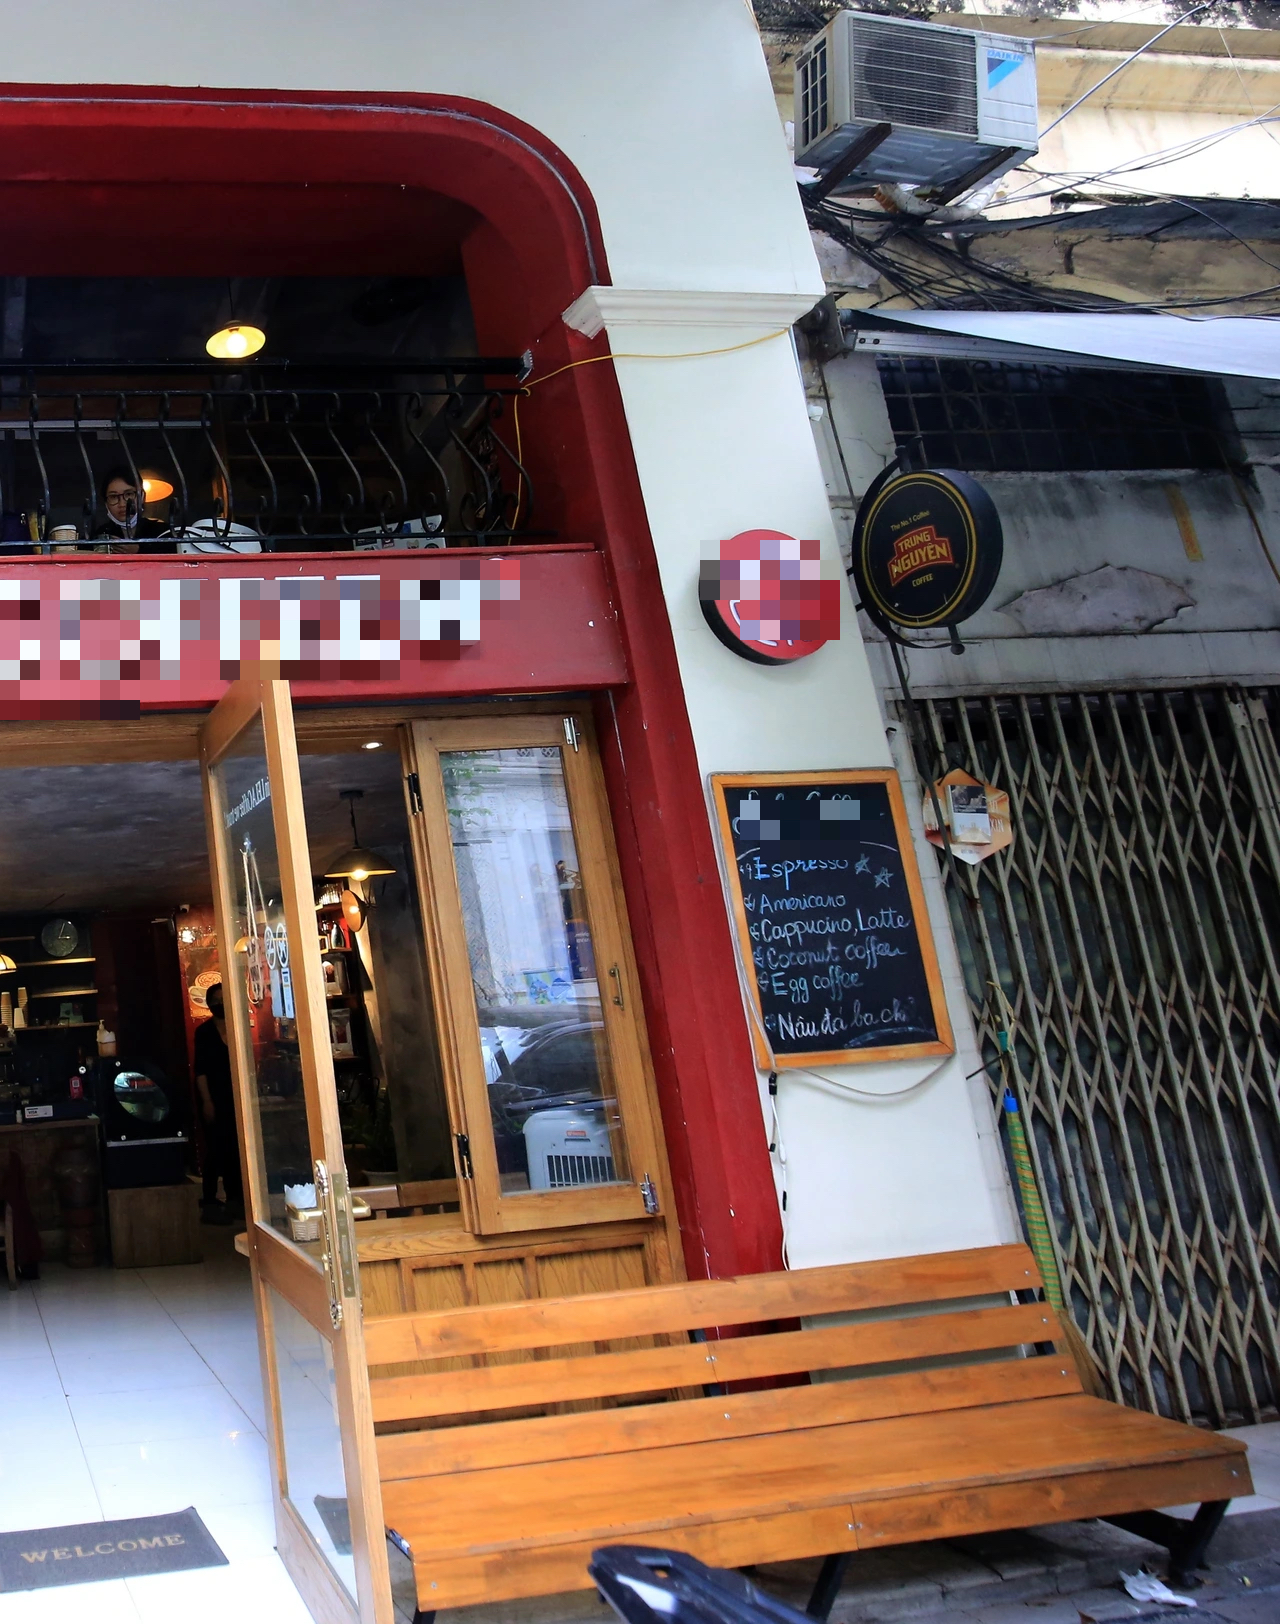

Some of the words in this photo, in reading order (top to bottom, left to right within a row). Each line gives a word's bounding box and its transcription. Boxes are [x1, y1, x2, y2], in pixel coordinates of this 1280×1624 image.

[987, 49, 1024, 61] DAIKIN
[898, 530, 931, 552] TRUNG
[891, 542, 948, 578] NGUYÊN
[912, 573, 934, 587] COFFEE
[753, 857, 848, 890] Espresso
[760, 894, 846, 914] Americano
[856, 907, 910, 931] Latte
[767, 937, 839, 969] Coconut
[771, 972, 809, 1003] Egg
[812, 965, 863, 1000] coffee
[20, 1533, 185, 1563] WELCOME
